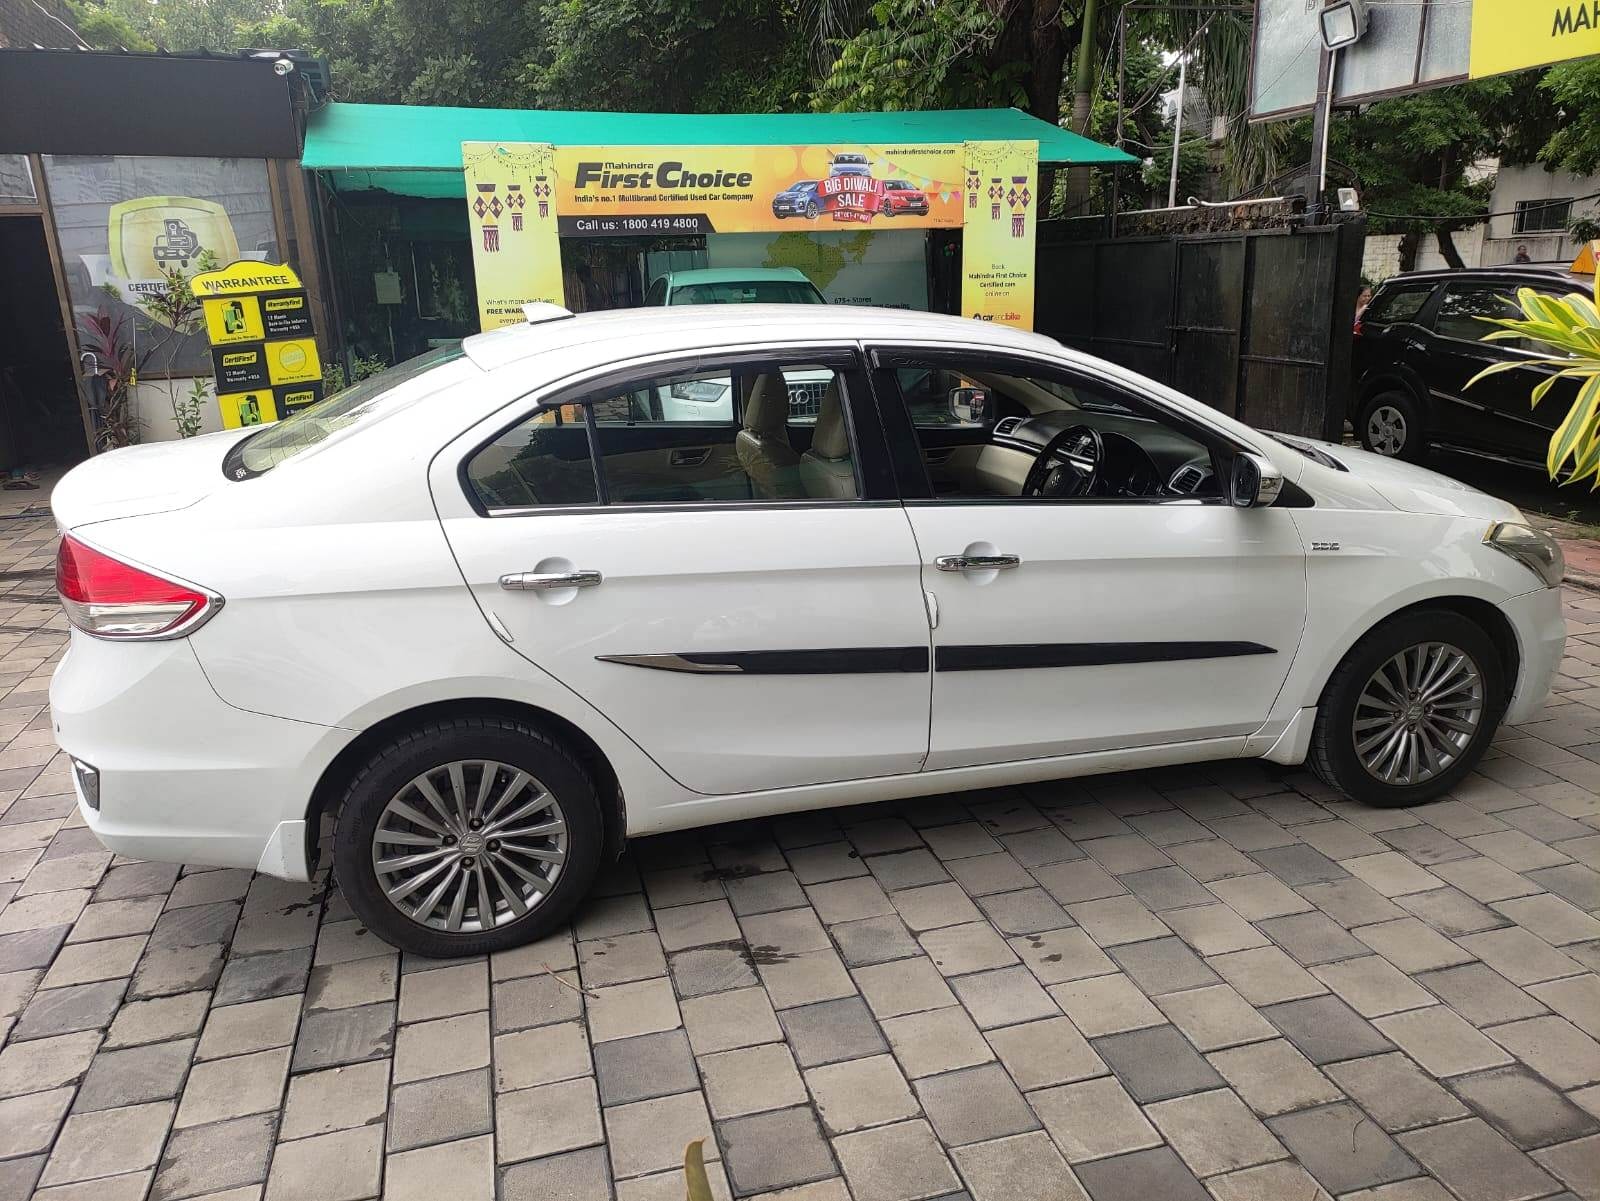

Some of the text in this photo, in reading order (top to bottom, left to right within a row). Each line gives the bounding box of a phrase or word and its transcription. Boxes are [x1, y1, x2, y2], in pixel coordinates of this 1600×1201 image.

[605, 161, 654, 170] Mahindra
[574, 161, 753, 189] First Choice
[824, 177, 879, 193] BIG DIWALI
[574, 194, 600, 203] India's
[618, 193, 657, 202] Multibrand
[658, 193, 689, 202] Certified
[690, 192, 708, 201] Used
[708, 193, 721, 201] Car
[722, 192, 754, 203] Company
[837, 193, 866, 207] SALE
[576, 217, 699, 230] Call us: 1800 419 4800
[968, 272, 995, 280] Mahindra
[128, 282, 169, 292] CERTIFI
[201, 275, 290, 291] WARRANTREE
[485, 298, 508, 306] What's
[486, 307, 525, 316] FREE WARR
